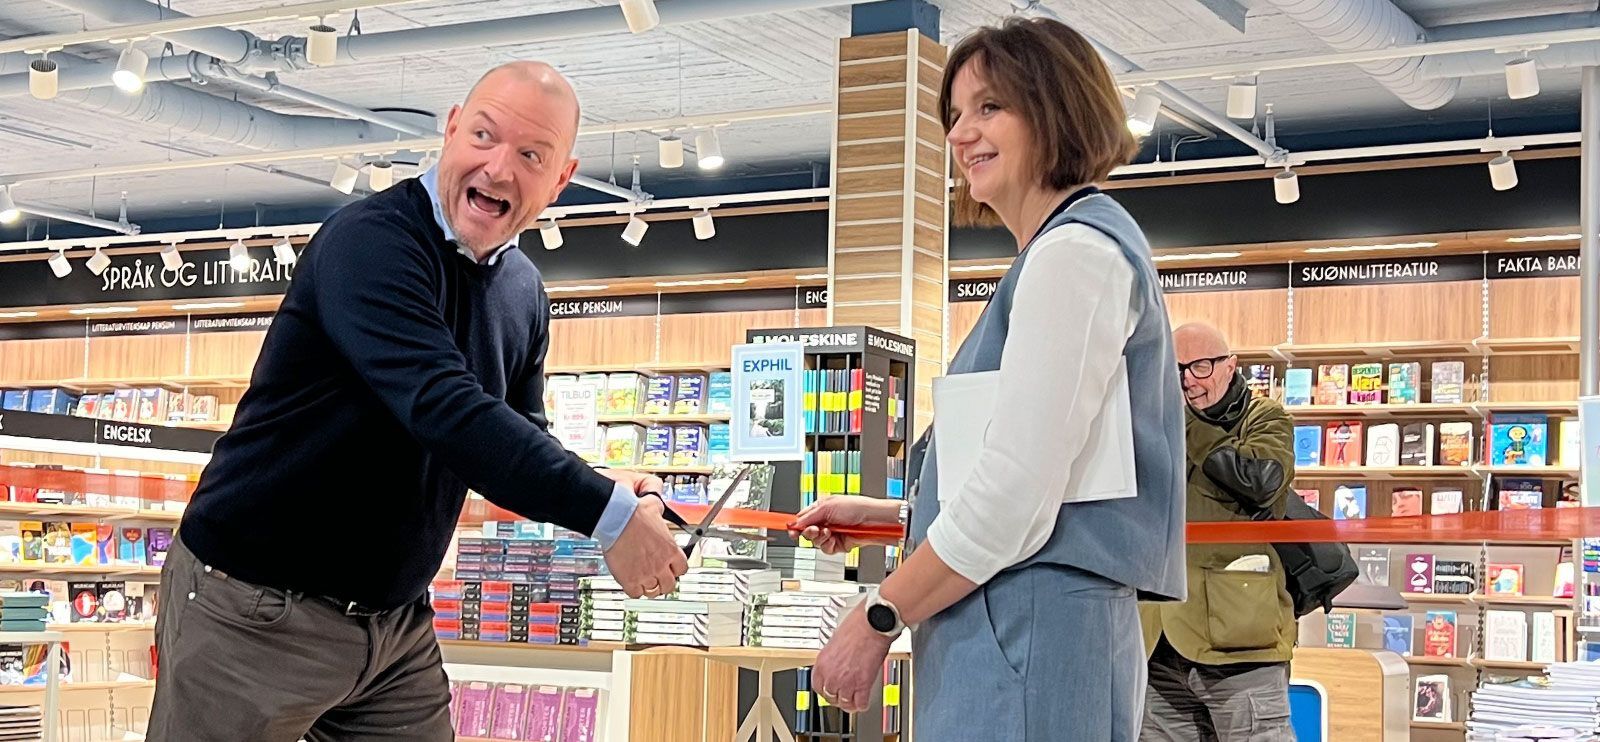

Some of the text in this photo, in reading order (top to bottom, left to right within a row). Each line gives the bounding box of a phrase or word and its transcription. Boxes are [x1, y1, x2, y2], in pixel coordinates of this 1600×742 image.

[1301, 261, 1438, 281] SKJØNNLITTERATUR
[1498, 257, 1543, 273] FAKTA
[102, 258, 155, 291] SPRÅK
[161, 262, 198, 287] OG
[549, 300, 623, 315] GELSK PENSUM
[151, 320, 175, 330] PENSUM
[873, 335, 914, 357] MOLESKINE
[743, 358, 793, 373] EXPHIL
[560, 390, 591, 400] TILBUD
[103, 424, 152, 443] ENGELSK
